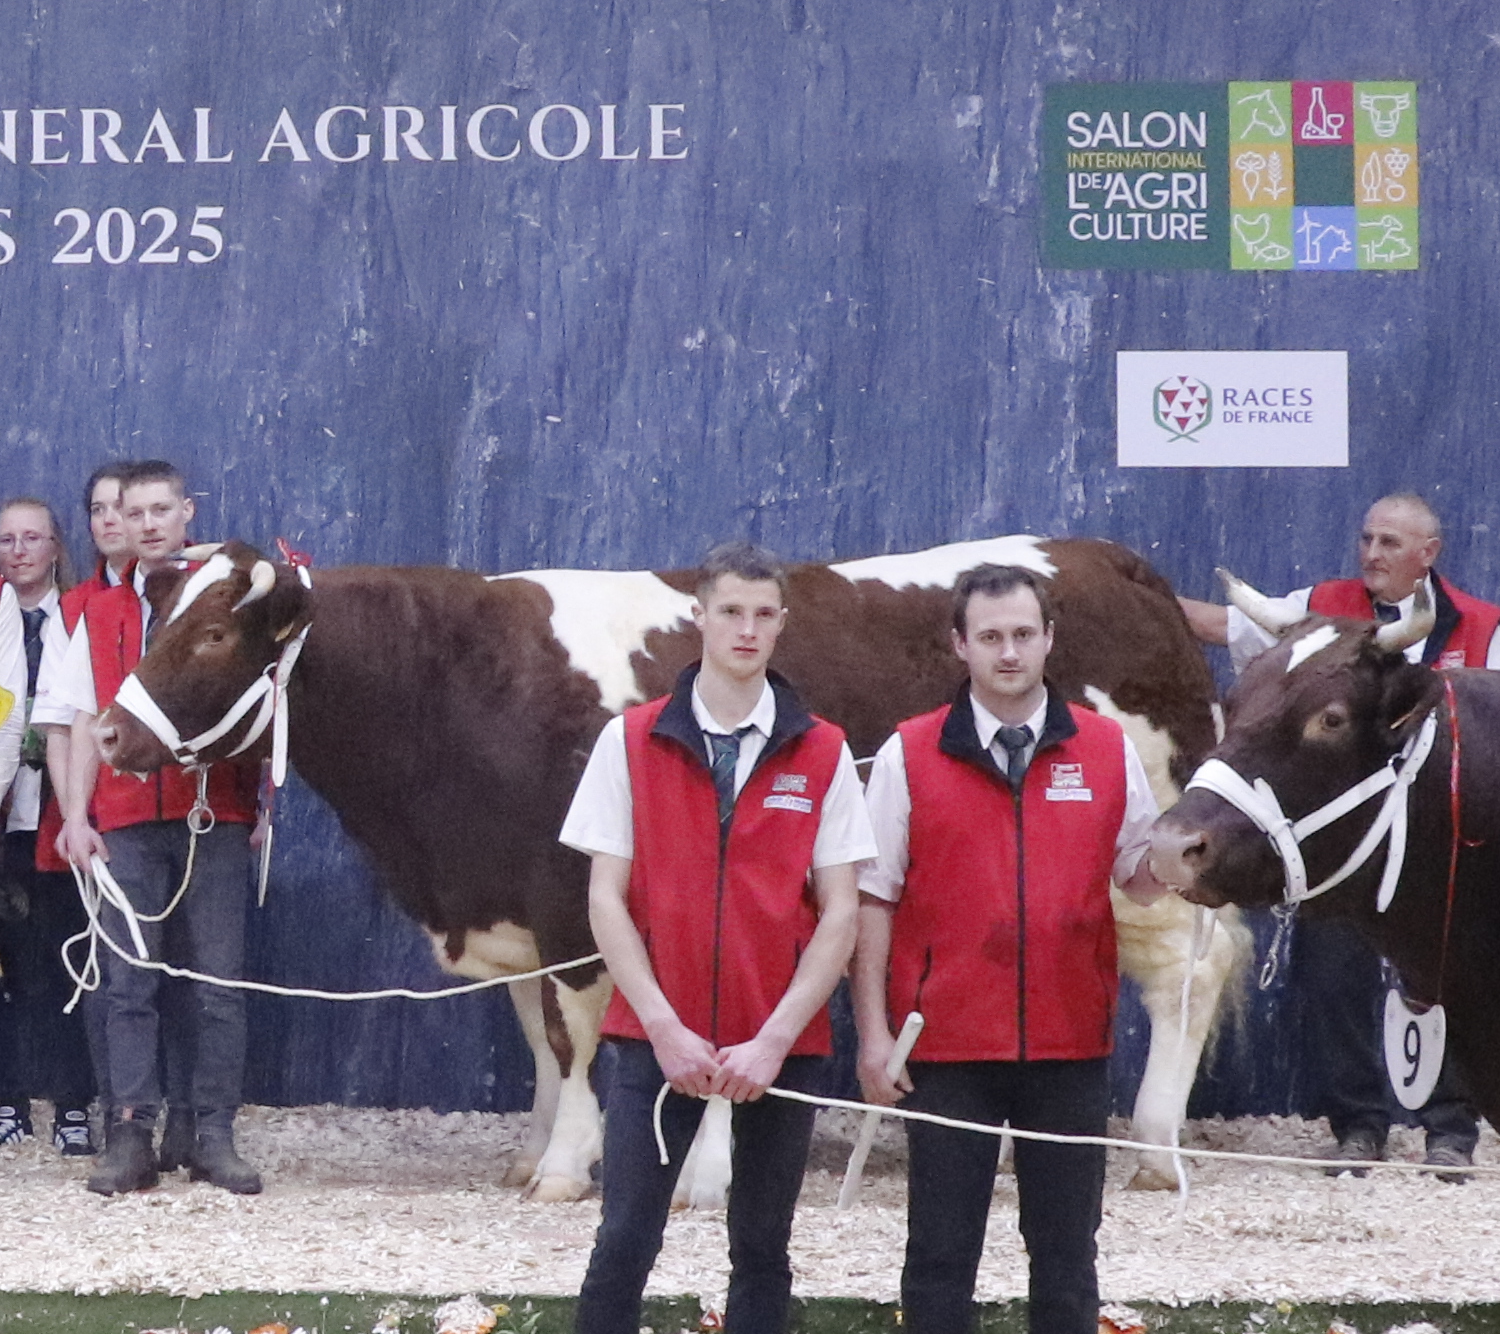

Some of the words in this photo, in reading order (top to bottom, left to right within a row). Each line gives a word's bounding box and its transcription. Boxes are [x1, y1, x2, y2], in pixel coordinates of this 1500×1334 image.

[257, 103, 691, 165] AGRICOLE
[1066, 110, 1208, 149] SALON
[1066, 152, 1207, 169] INTERNATIONAL
[51, 206, 226, 265] 2025
[1068, 212, 1208, 242] CULTURE
[1222, 387, 1313, 407] RACES
[1222, 411, 1244, 424] DE
[1247, 410, 1314, 424] FRANCE
[1403, 1020, 1422, 1087] 9
